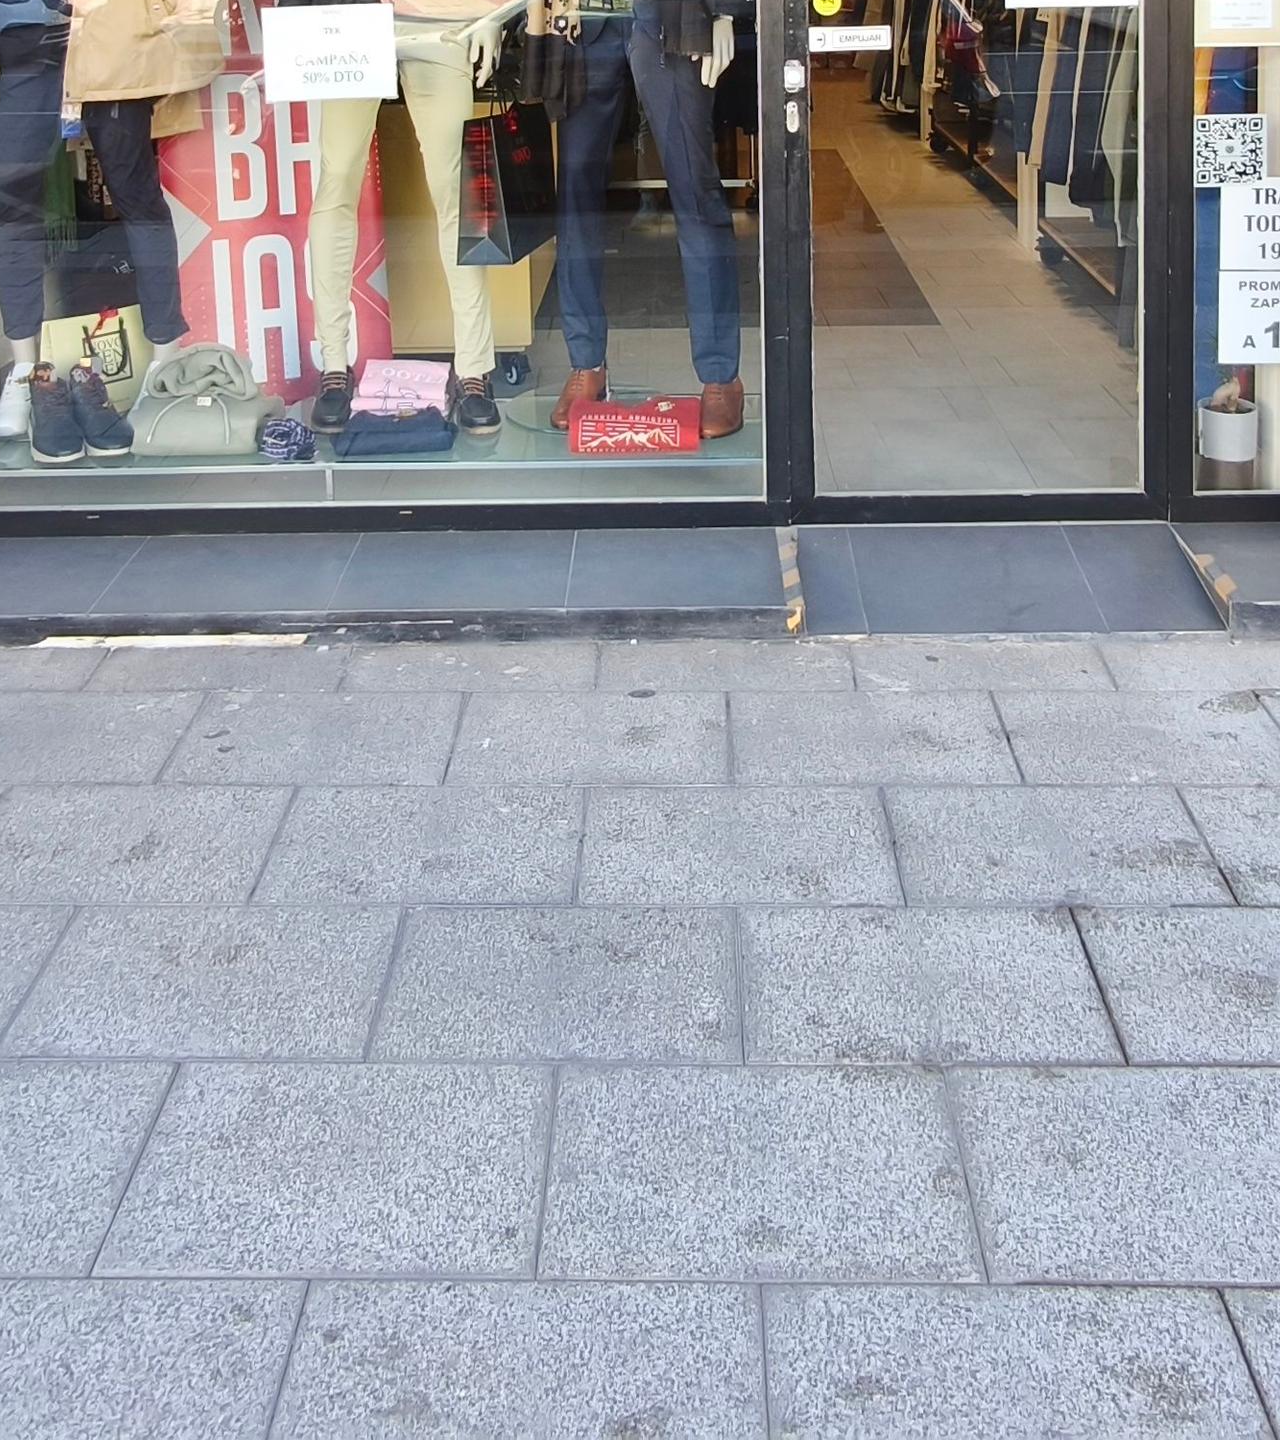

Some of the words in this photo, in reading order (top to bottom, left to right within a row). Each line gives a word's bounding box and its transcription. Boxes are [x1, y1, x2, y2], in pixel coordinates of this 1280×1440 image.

[302, 71, 331, 84] 50%
[333, 70, 365, 83] DTO
[1243, 335, 1257, 349] A
